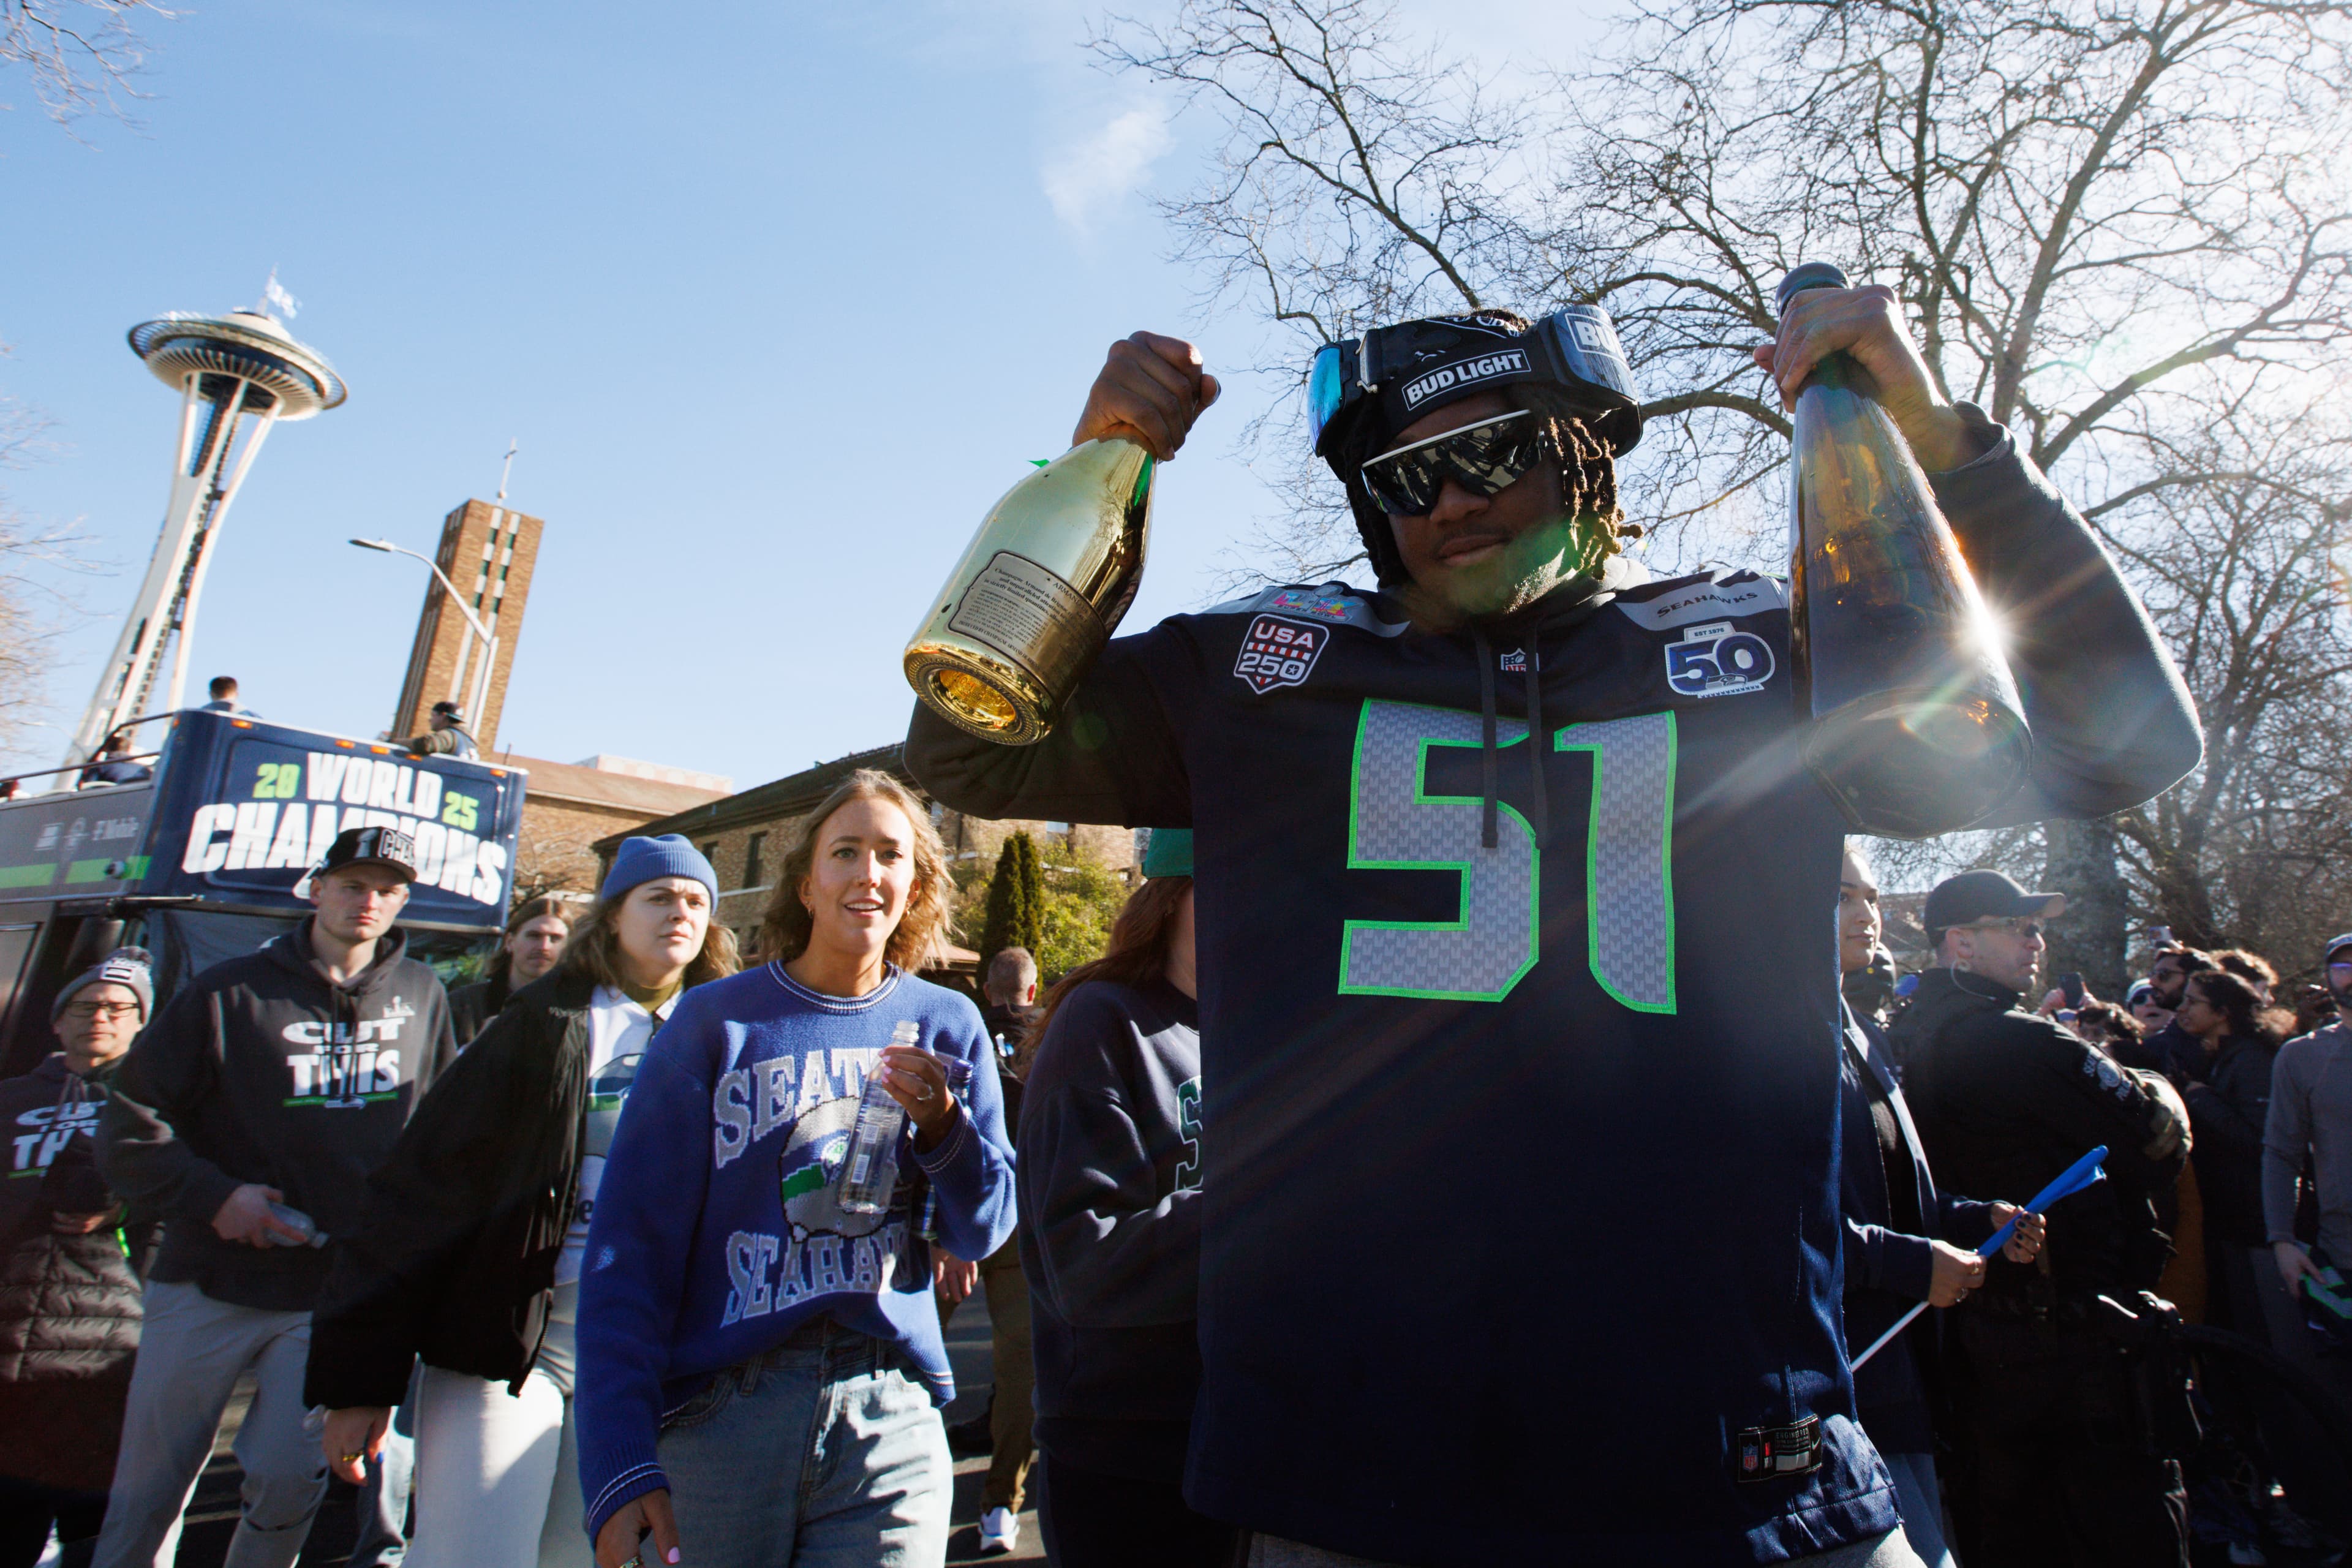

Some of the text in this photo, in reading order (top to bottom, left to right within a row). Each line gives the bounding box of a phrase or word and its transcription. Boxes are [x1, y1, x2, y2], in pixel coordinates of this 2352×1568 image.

[1573, 320, 1622, 355] BU
[1406, 353, 1522, 405] BUD LIGHT
[989, 579, 1006, 590] strictly
[1006, 586, 1025, 599] limited
[995, 568, 1024, 583] Champagne
[1025, 581, 1045, 594] Armand
[1009, 581, 1040, 600] unparalleled
[1656, 592, 1758, 618] SEAHAWKS
[1255, 623, 1313, 650] USA
[1238, 652, 1306, 679] 250
[1668, 635, 1772, 693] 50
[253, 752, 479, 831] 20 WORLD 25
[1338, 697, 1677, 1015] 51
[282, 1017, 405, 1044] CUT
[314, 1042, 380, 1054] FOR
[287, 1049, 400, 1096] THIS
